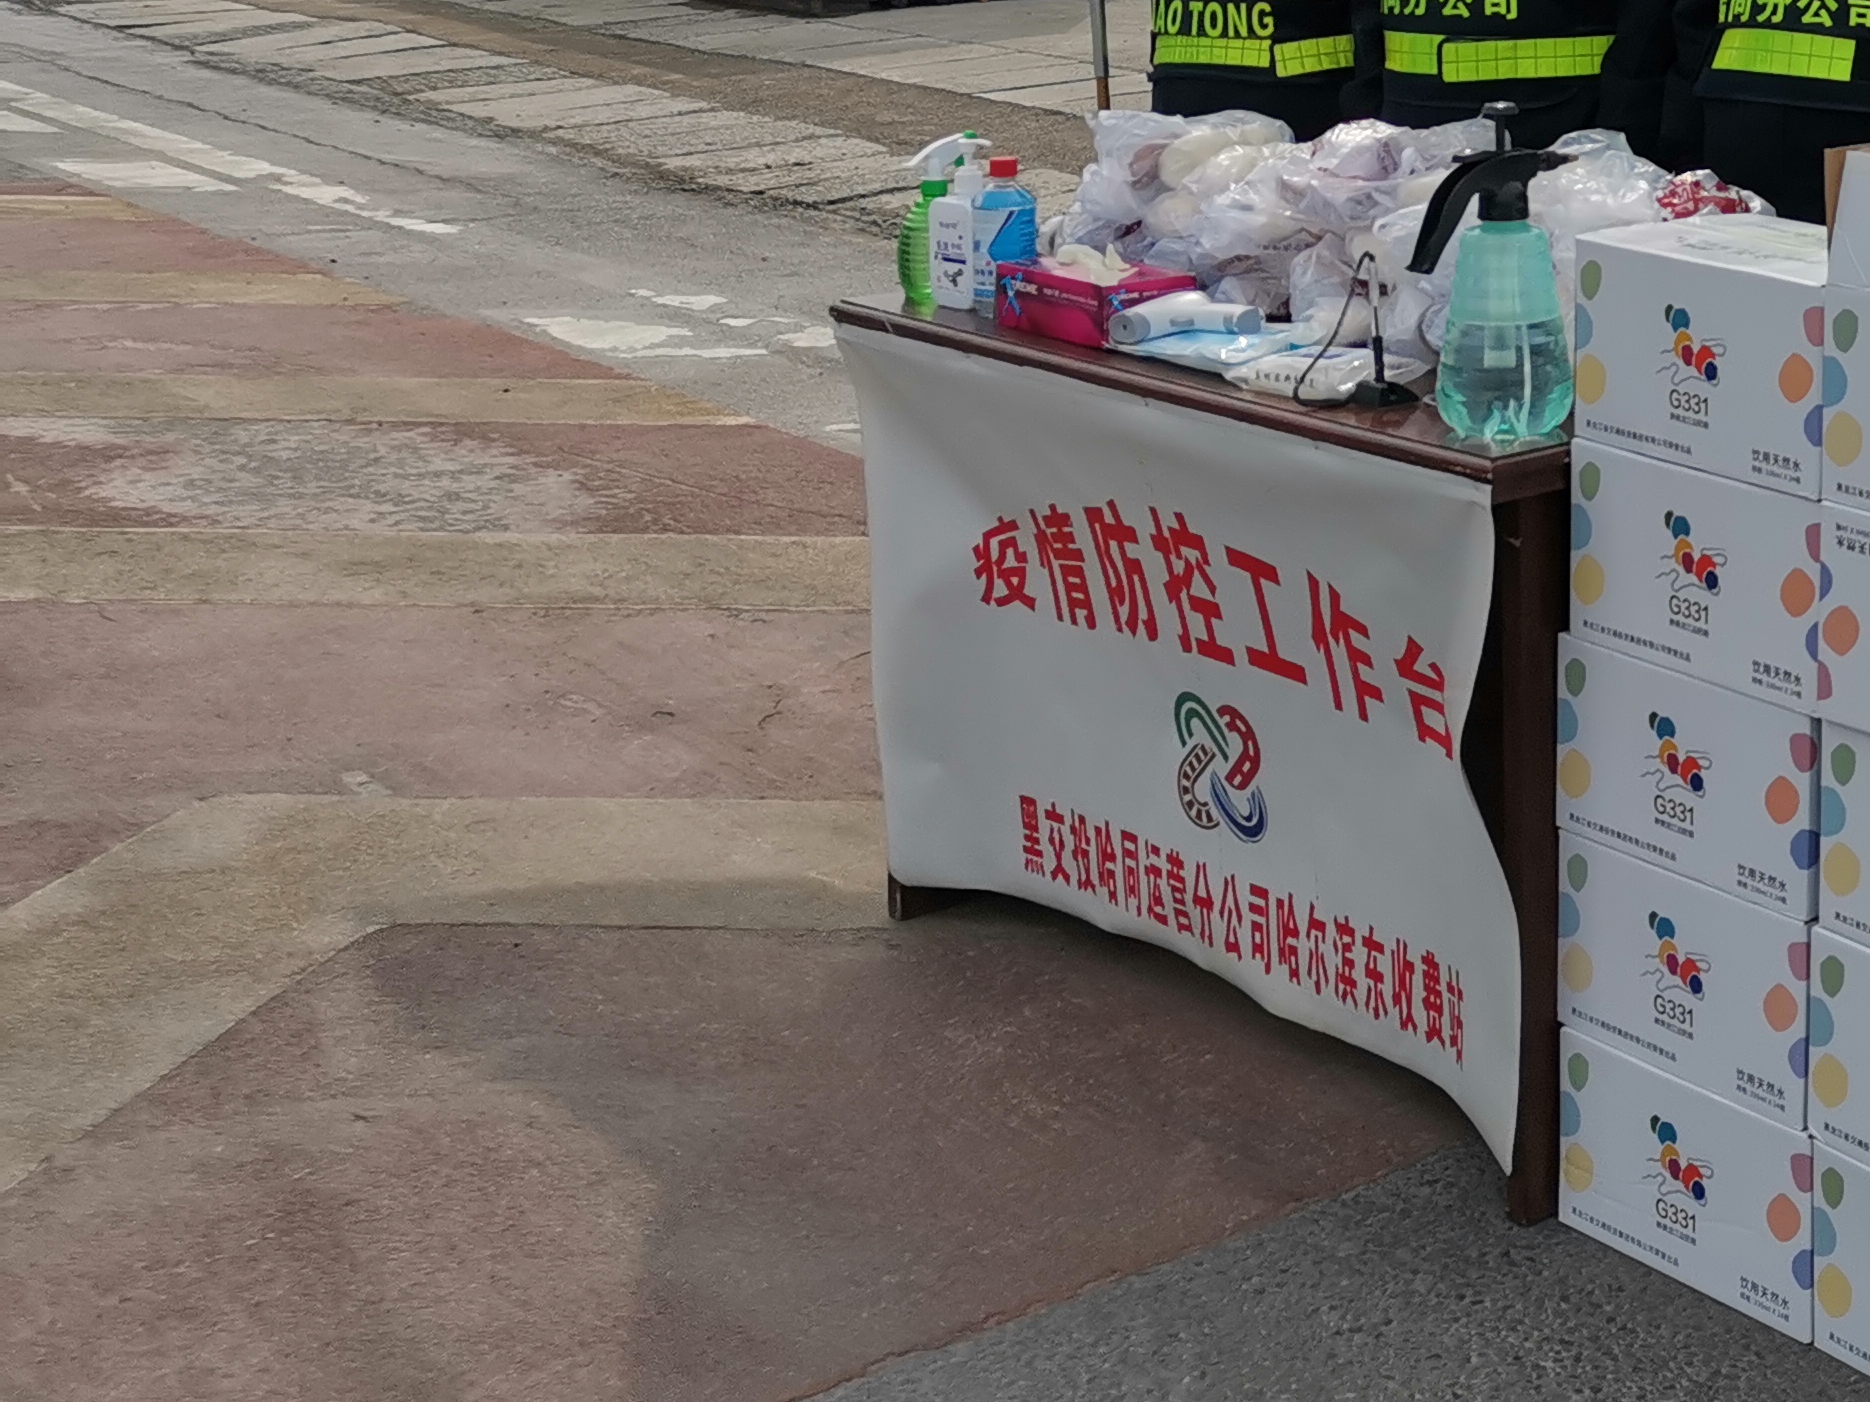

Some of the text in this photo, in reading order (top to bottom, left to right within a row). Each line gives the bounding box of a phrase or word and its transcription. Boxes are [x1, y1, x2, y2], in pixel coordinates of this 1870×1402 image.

[1189, 0, 1275, 38] TONG
[1669, 389, 1709, 417] G331
[1751, 448, 1803, 474] 饮用天然水
[1669, 595, 1710, 625] G331
[971, 499, 1453, 760] 疫情防控工作台
[1751, 659, 1803, 688] 饮用天然水
[1653, 795, 1695, 827] G331
[1737, 863, 1788, 894] 饮用天然水
[1018, 795, 1465, 1071] 黑交投哈同运营分公司哈尔滨东收费站
[1653, 994, 1695, 1029] G331
[1736, 1067, 1786, 1101] 饮用天然水
[1655, 1198, 1697, 1235] G331
[1739, 1275, 1791, 1311] 饮用天然水
